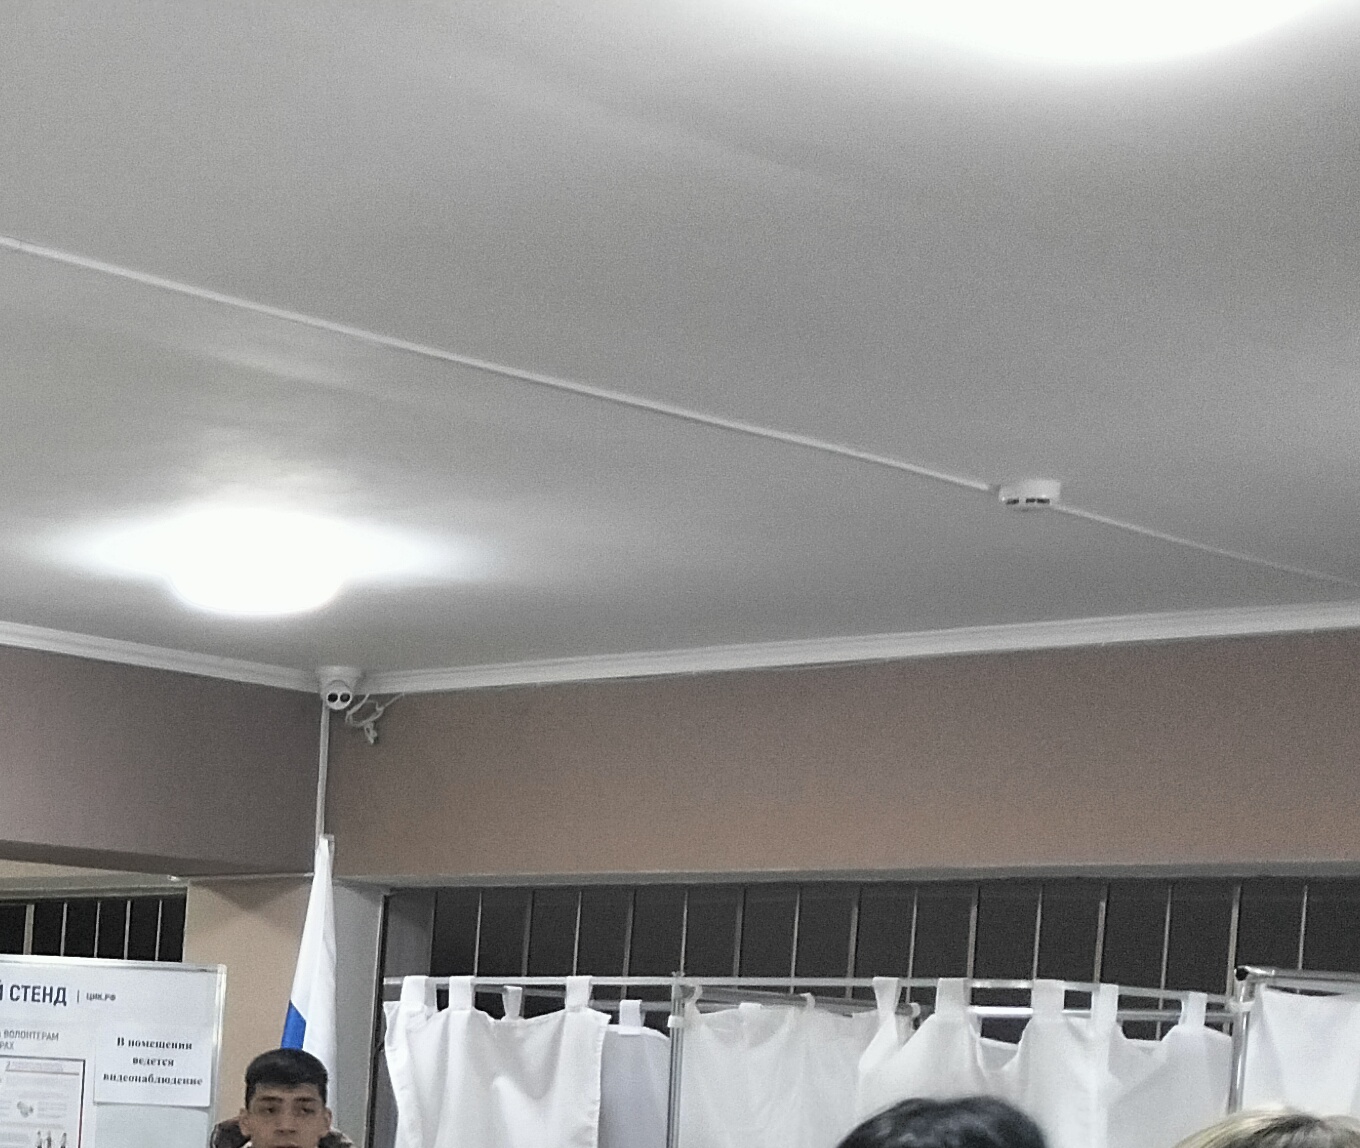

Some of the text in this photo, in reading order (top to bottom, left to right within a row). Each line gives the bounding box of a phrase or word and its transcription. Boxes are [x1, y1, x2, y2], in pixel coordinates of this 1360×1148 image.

[9, 984, 67, 1006] СТЕНД
[4, 1029, 59, 1041] ВОЛОНТЕРАМ
[117, 1037, 192, 1050] В помещении
[132, 1057, 174, 1067] ведется
[103, 1073, 203, 1085] видеонаблюдение
